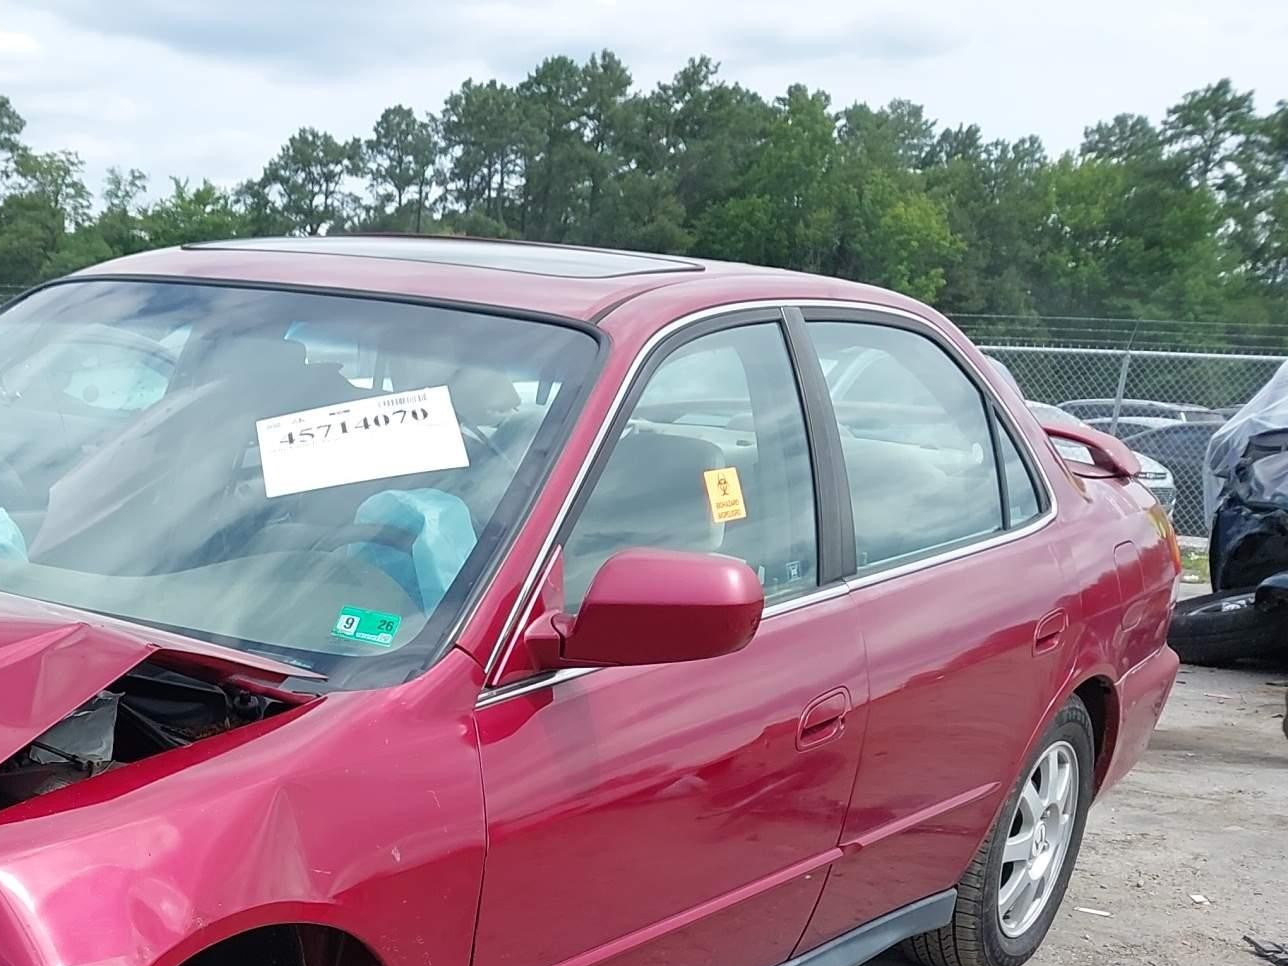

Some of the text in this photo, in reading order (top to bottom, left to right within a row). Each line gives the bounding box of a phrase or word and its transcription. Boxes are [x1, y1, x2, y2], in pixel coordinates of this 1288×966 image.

[280, 408, 429, 445] 45714070
[343, 617, 394, 631] 9 26
